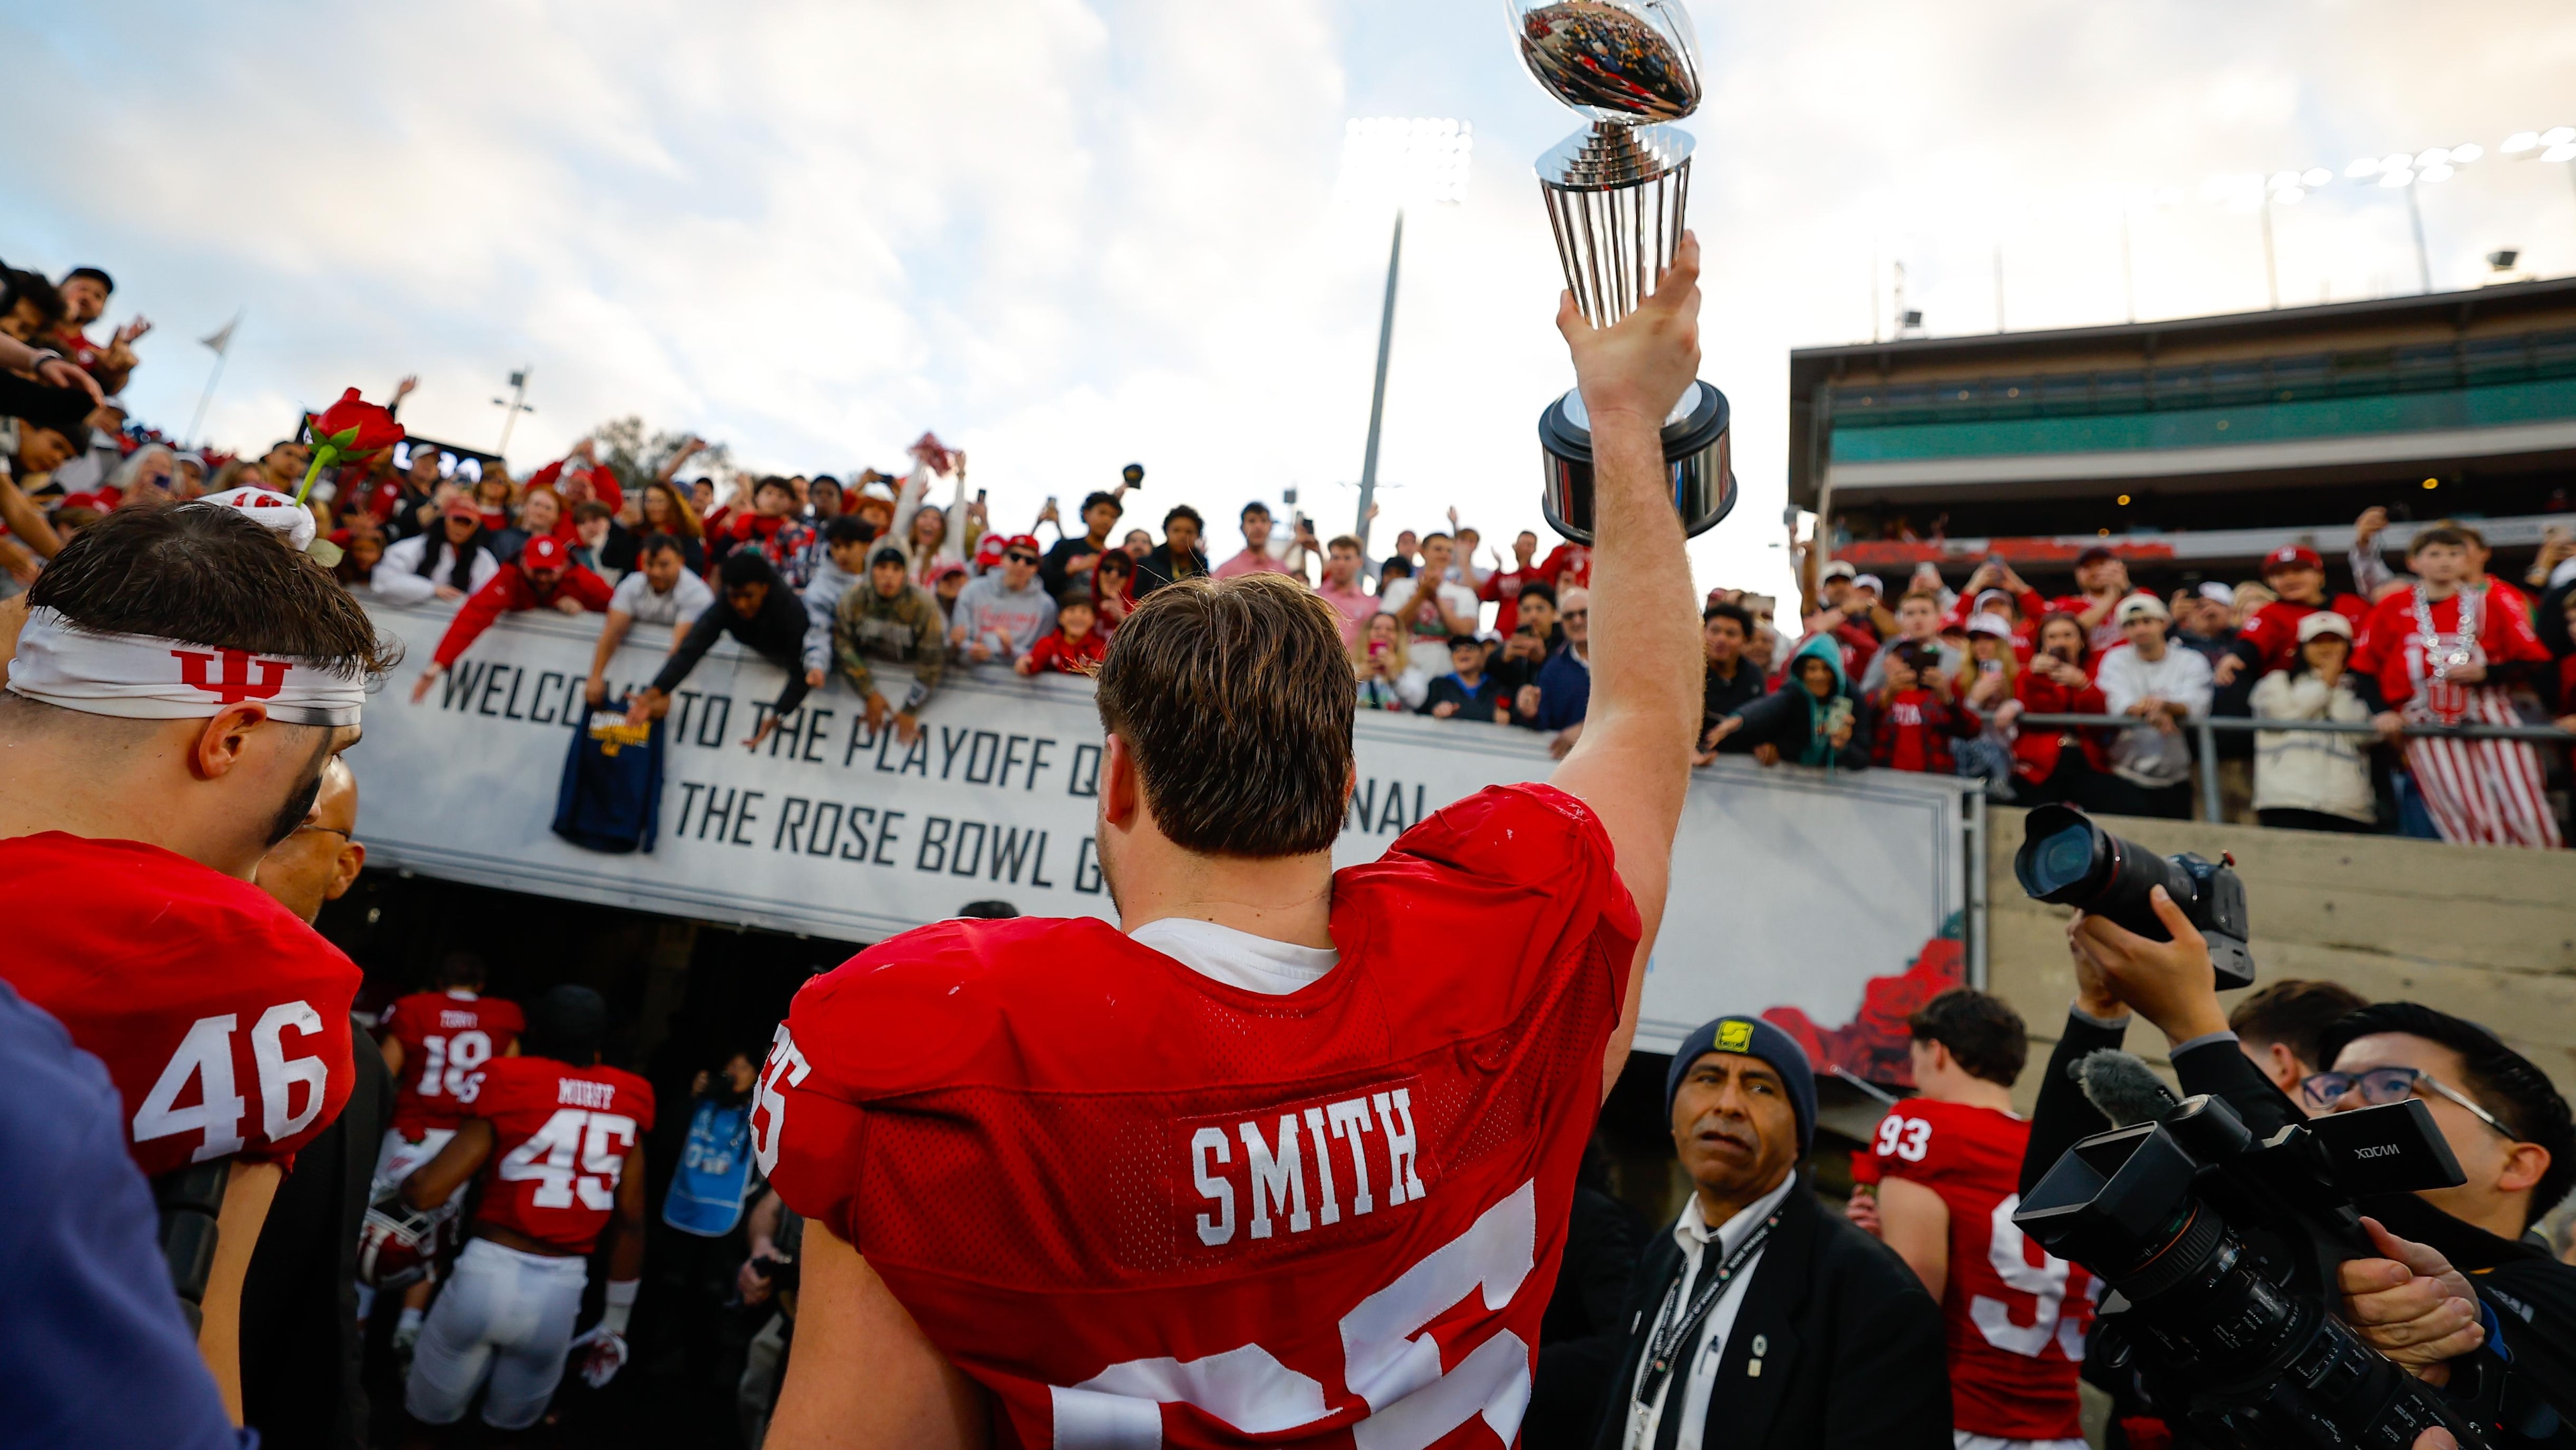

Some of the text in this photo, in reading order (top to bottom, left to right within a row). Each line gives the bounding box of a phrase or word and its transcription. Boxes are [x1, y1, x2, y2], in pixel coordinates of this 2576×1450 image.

[442, 661, 652, 727] WELCO
[676, 691, 732, 748] TO
[751, 700, 835, 763] THE
[844, 716, 1057, 791] PLAYOFF
[676, 782, 766, 846] THE
[773, 797, 906, 867] ROSE
[916, 816, 1053, 889] BOWL
[133, 1000, 328, 1163] 46
[499, 1109, 637, 1211] 45
[1191, 1088, 1427, 1247] SMITH
[1876, 1114, 1933, 1162] 93
[2353, 1144, 2401, 1160] XDCAM
[2242, 1317, 2257, 1331] FOCUS
